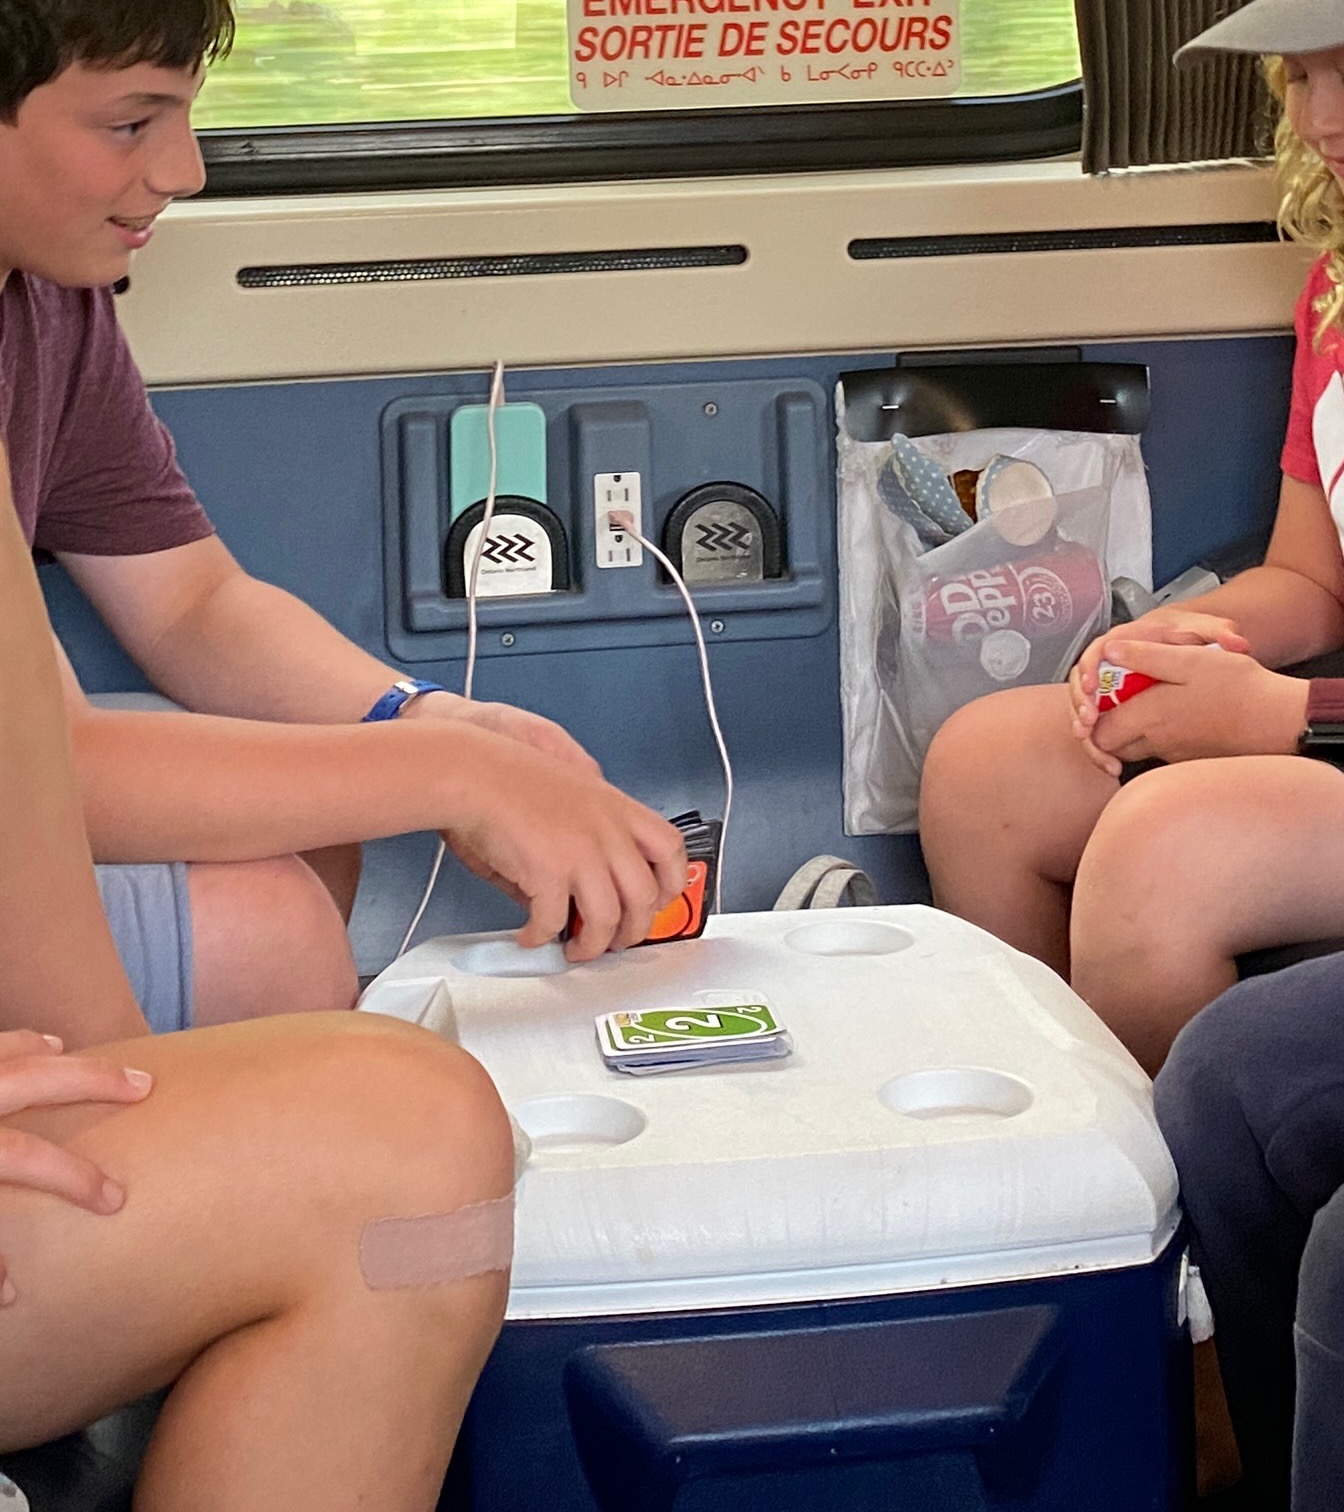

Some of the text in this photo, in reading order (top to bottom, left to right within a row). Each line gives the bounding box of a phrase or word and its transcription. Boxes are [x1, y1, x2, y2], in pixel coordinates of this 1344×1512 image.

[574, 14, 954, 63] SORTIE DE SECOURS
[1031, 591, 1056, 620] 23
[665, 1014, 722, 1031] 2
[628, 1034, 655, 1044] 2
